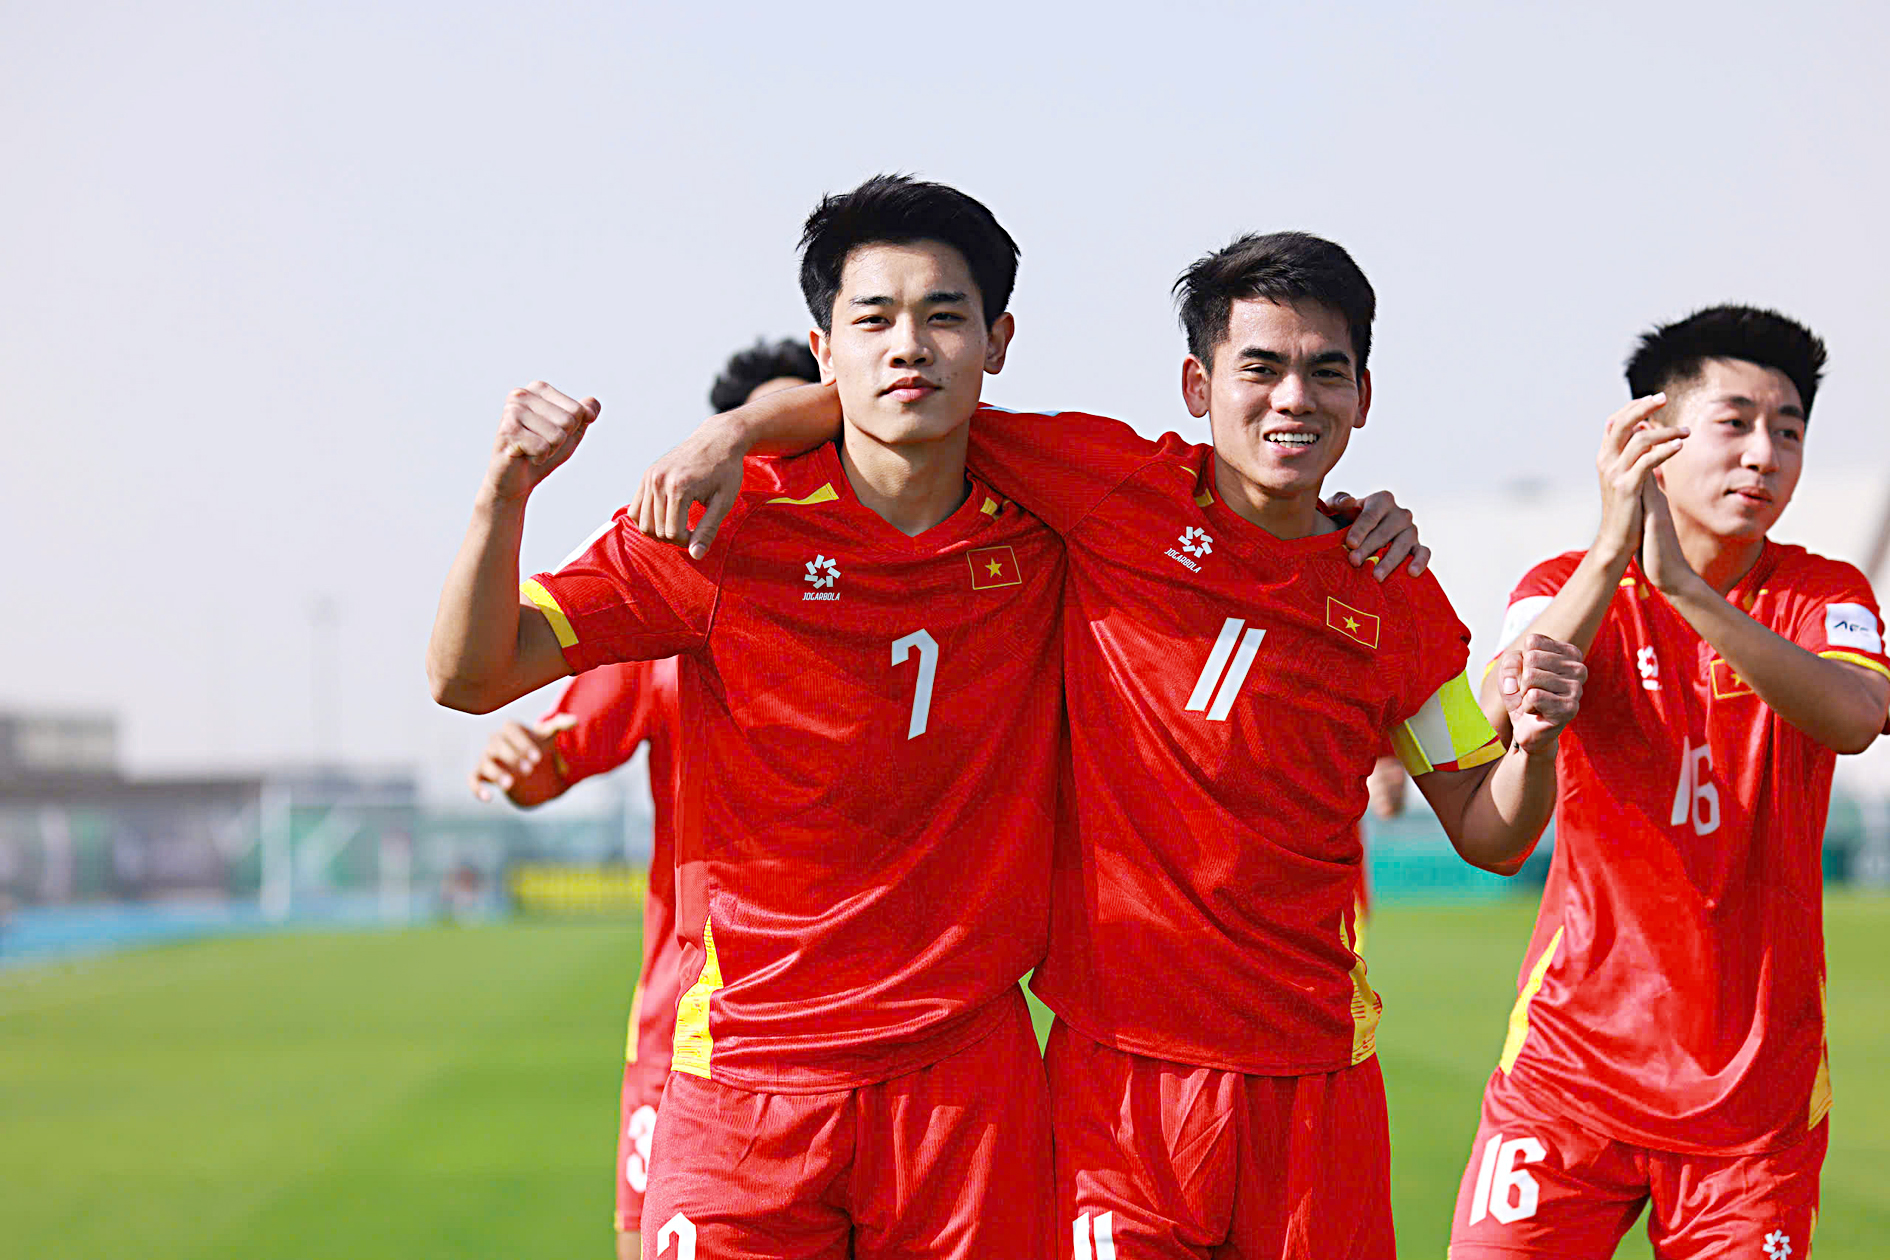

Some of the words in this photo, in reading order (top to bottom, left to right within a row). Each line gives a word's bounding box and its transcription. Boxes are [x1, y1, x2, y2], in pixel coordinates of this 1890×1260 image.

[891, 628, 939, 740] 7
[1184, 617, 1267, 721] 11
[1671, 736, 1720, 836] 16
[1470, 1133, 1547, 1226] 16
